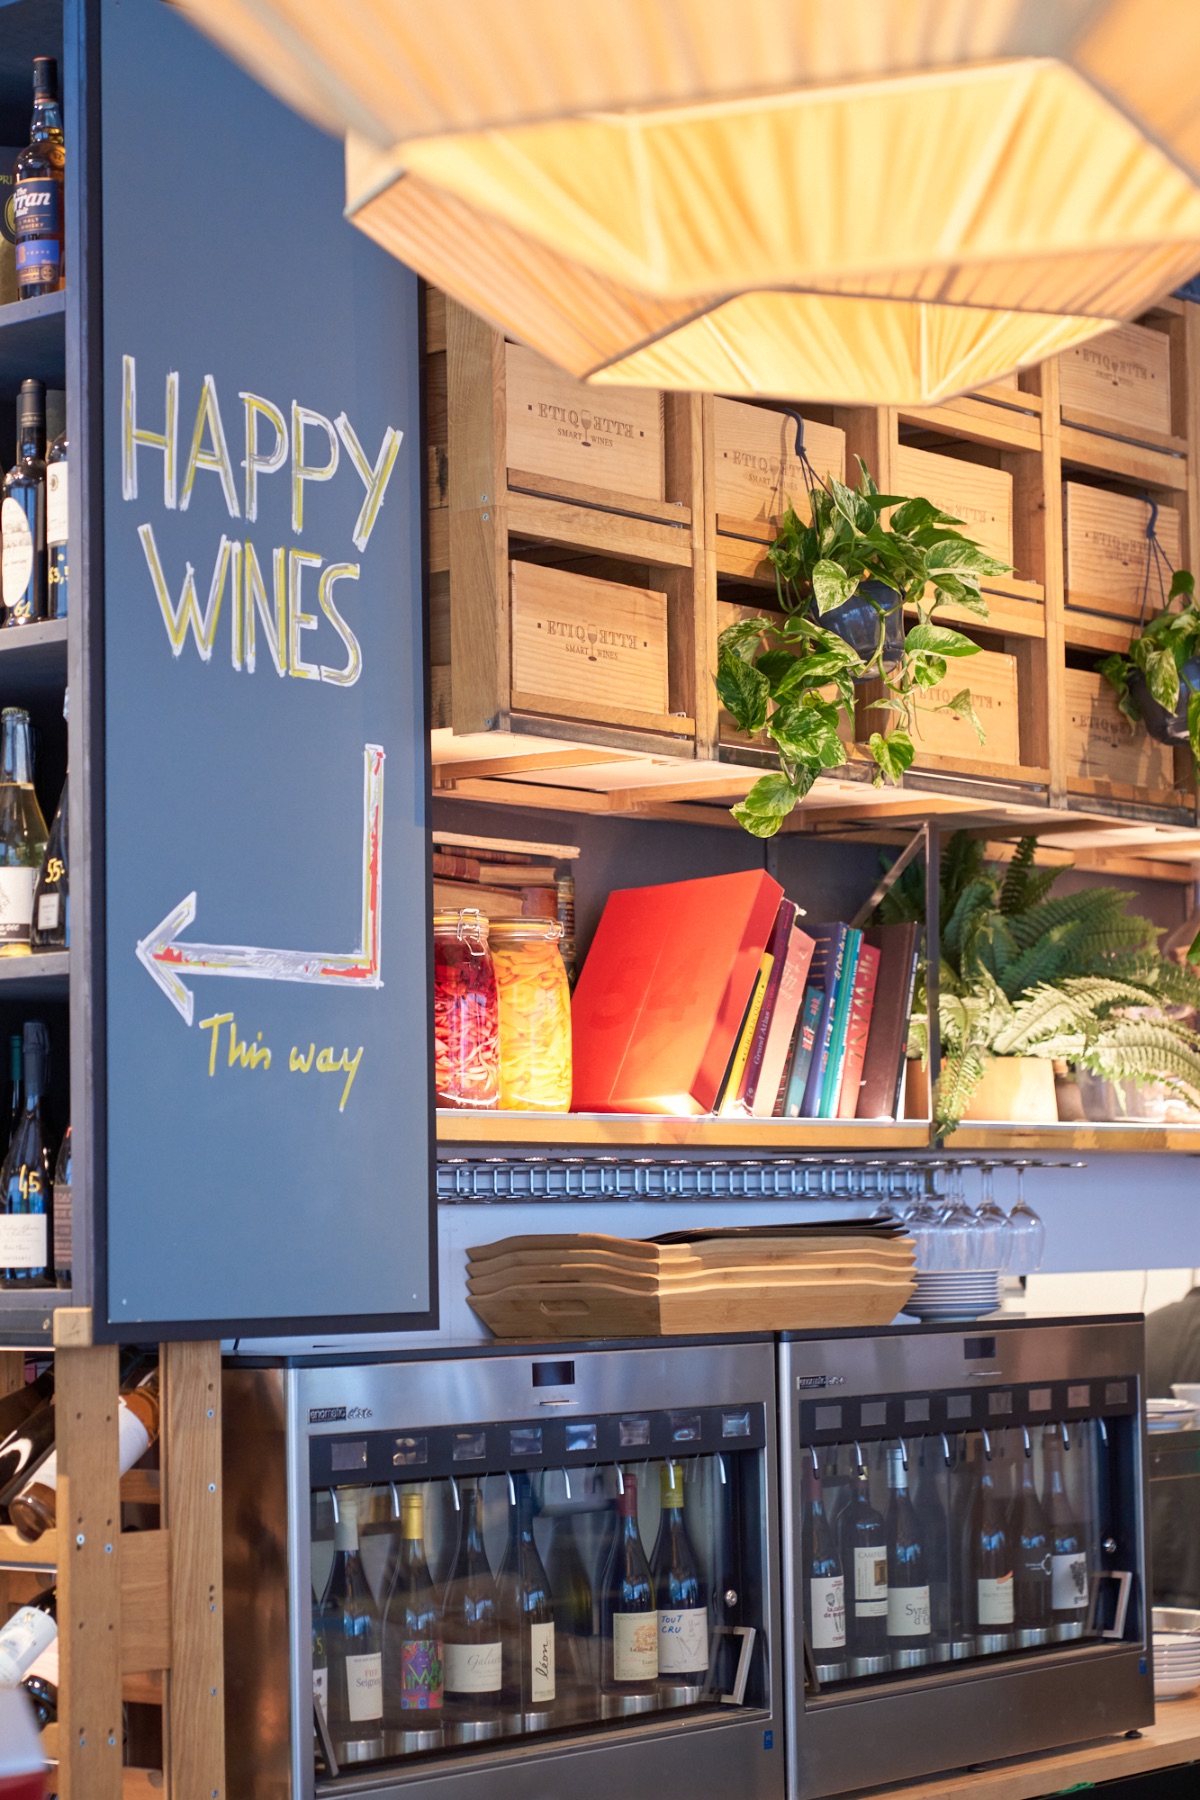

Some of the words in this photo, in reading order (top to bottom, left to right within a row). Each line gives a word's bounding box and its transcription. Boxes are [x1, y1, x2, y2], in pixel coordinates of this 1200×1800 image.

[14, 191, 51, 209] rran
[557, 428, 583, 441] SMART
[591, 435, 614, 448] WINES
[122, 353, 405, 552] HAPPY
[748, 473, 771, 486] SMART
[137, 522, 363, 688] WINES
[565, 644, 590, 657] SMART
[597, 649, 619, 661] WINES
[753, 1034, 765, 1065] Grand
[760, 1010, 771, 1035] Atlas
[199, 1012, 271, 1077] This
[289, 1042, 364, 1113] way
[19, 1163, 42, 1200] 45
[661, 1614, 683, 1624] TOUT
[661, 1625, 682, 1634] CRU
[535, 1640, 549, 1680] léon
